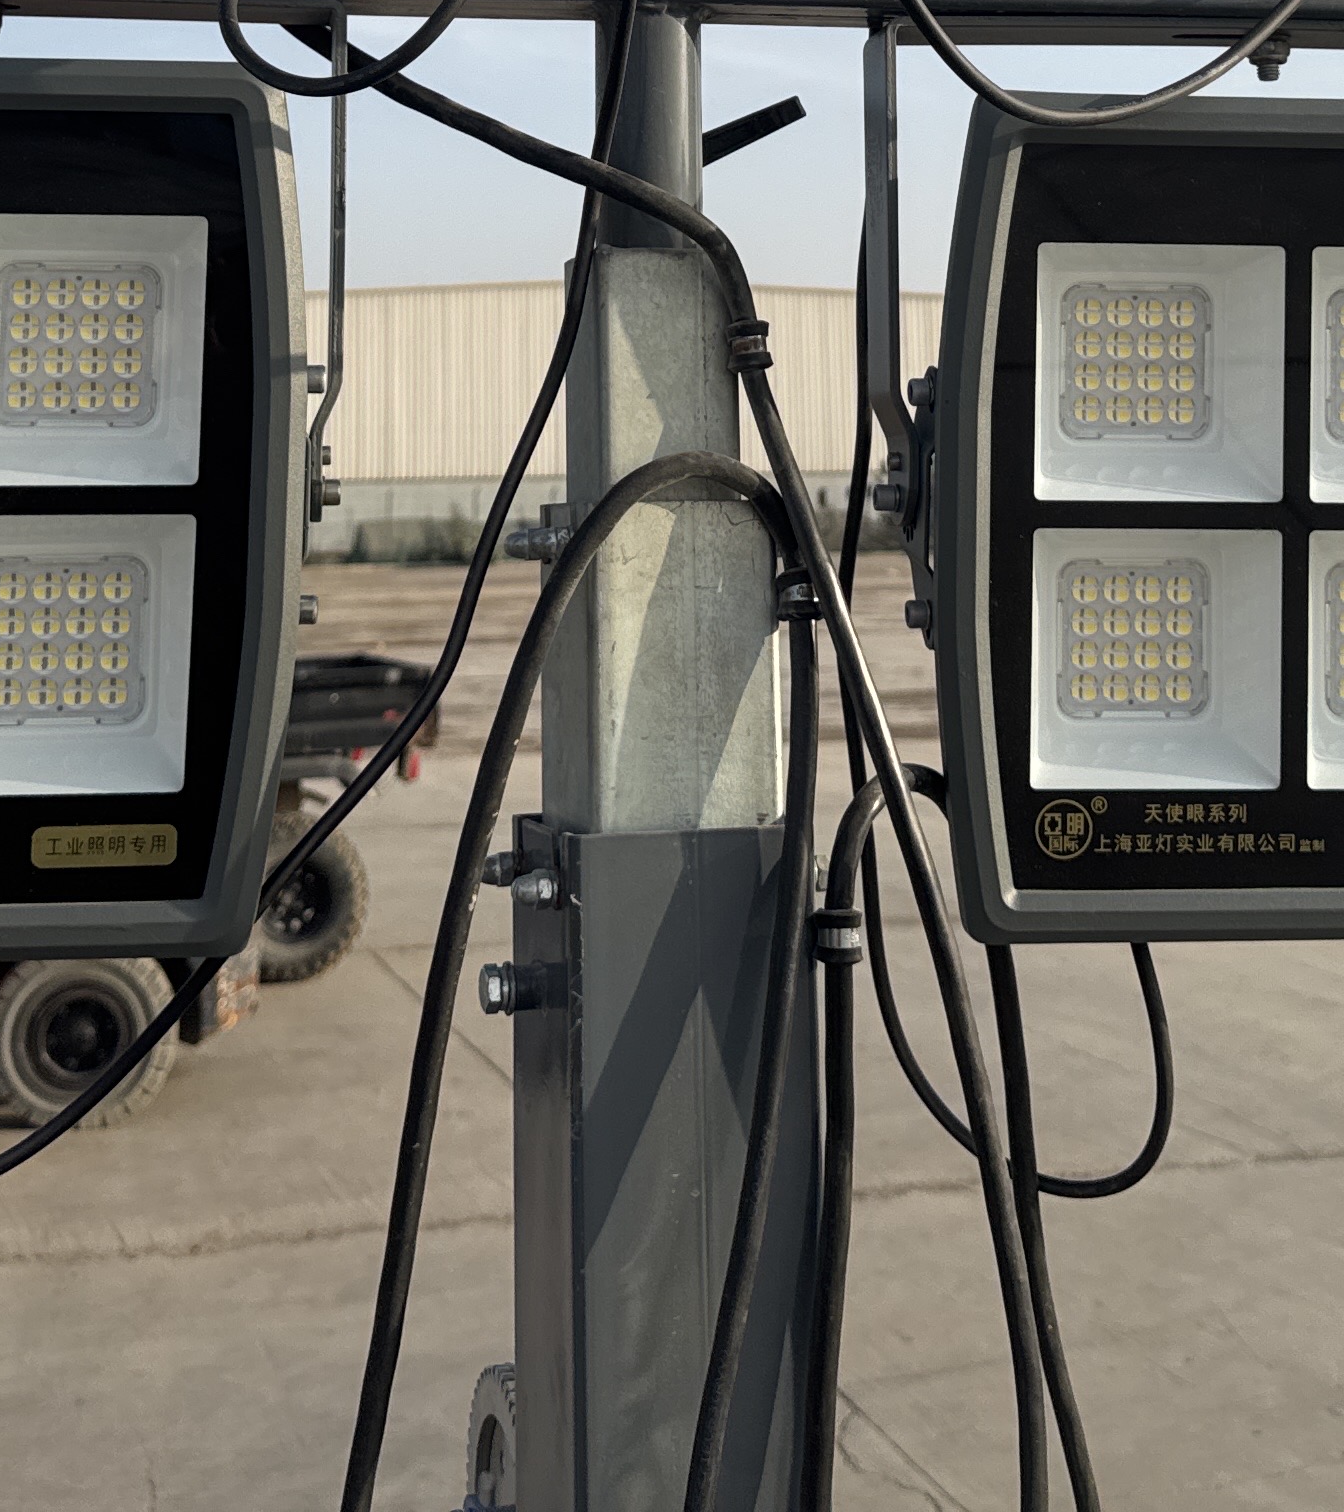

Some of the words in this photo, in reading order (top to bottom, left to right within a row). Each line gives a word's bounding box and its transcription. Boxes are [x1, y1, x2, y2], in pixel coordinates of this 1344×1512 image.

[1144, 803, 1248, 824] 天使眼系列
[44, 834, 168, 857] 工业照明专用
